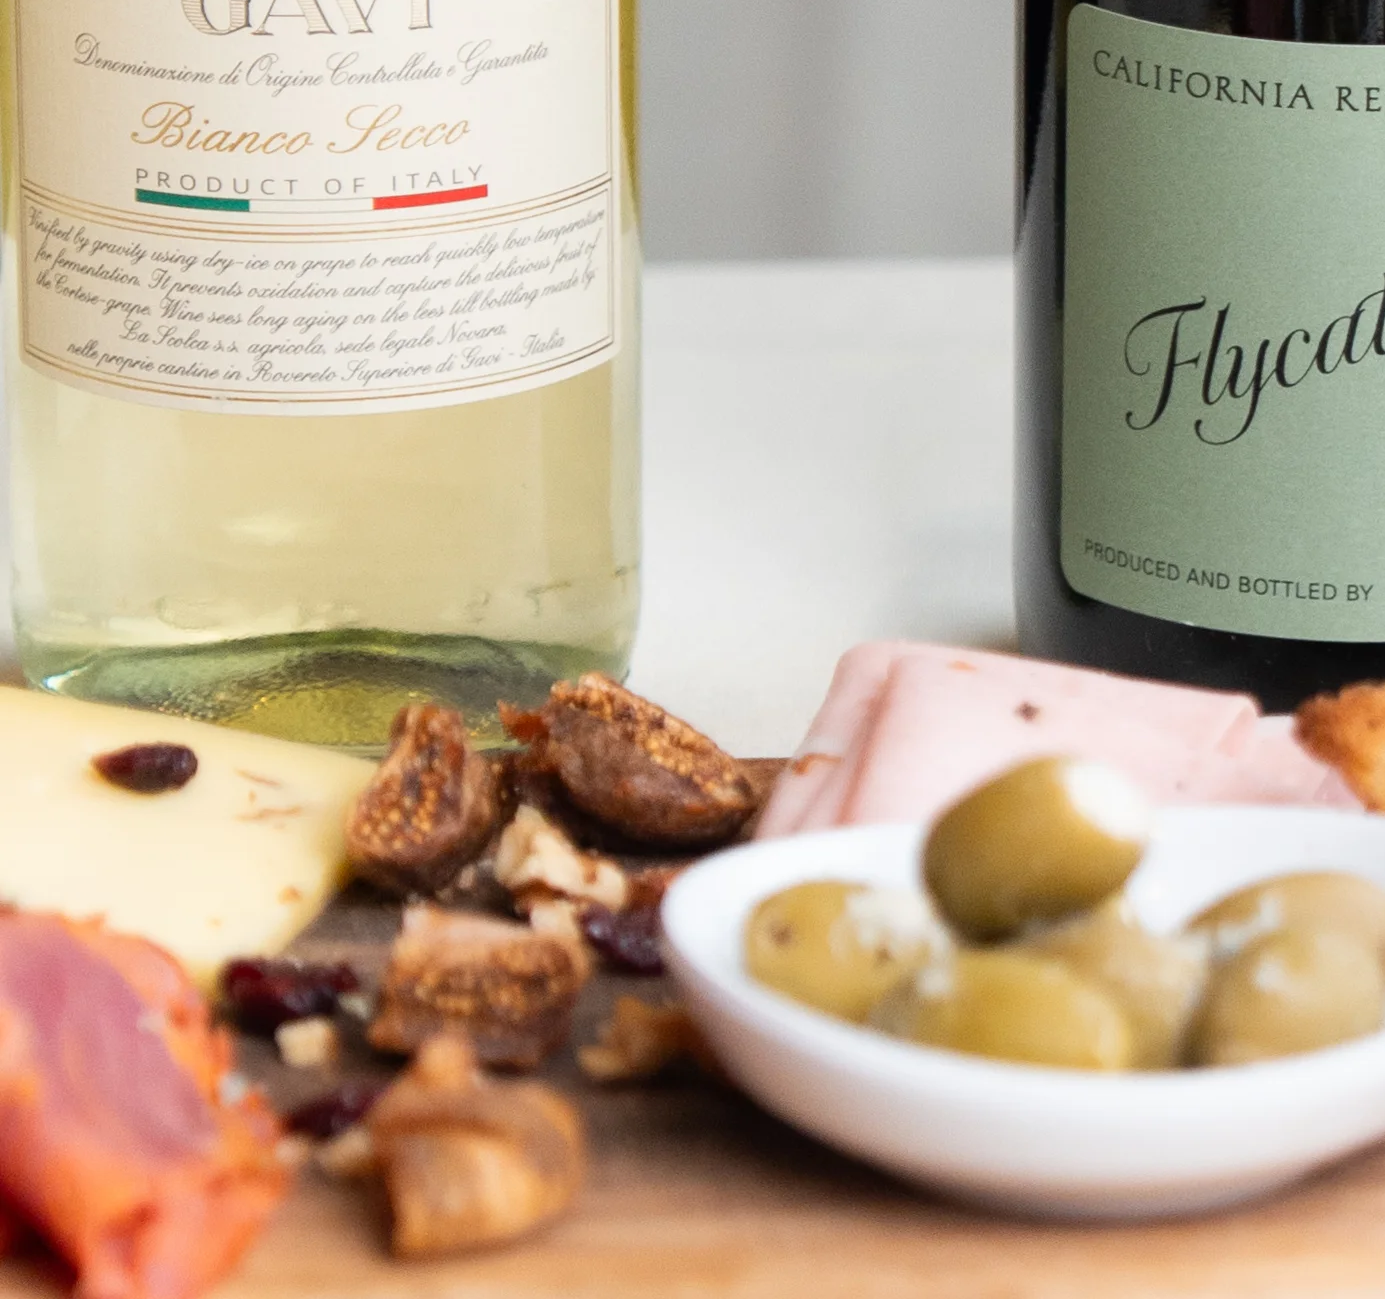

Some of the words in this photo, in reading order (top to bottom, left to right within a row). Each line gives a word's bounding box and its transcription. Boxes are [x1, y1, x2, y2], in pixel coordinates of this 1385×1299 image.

[73, 32, 215, 85] Denominazione
[218, 63, 240, 86] di
[245, 52, 323, 98] Origine
[325, 50, 442, 87] Controllata
[446, 65, 457, 77] e
[457, 38, 549, 86] Garantita
[1092, 49, 1315, 111] CALIFORNIA
[130, 101, 314, 155] Bianco
[326, 104, 471, 155] Secco
[135, 167, 299, 196] PRODUCT
[324, 177, 367, 196] OF
[391, 164, 484, 192] ITALY
[34, 241, 52, 263] for
[147, 267, 171, 290] It
[164, 278, 243, 300] prevents
[246, 280, 339, 299] oxidation
[342, 276, 387, 298] and
[385, 275, 452, 301] capture
[454, 262, 481, 287] the
[484, 255, 550, 283] delicious
[72, 226, 90, 253] by
[88, 241, 148, 265] gravity
[150, 247, 198, 272] using
[273, 259, 297, 271] on
[295, 259, 355, 279] grape
[359, 252, 378, 269] to
[381, 241, 432, 267] reach
[435, 231, 499, 269] quickly
[501, 227, 531, 252] low
[36, 268, 52, 290] the
[160, 297, 205, 320] Wine
[206, 311, 243, 325] sees
[246, 304, 290, 335] long
[292, 310, 350, 336] aging
[351, 312, 377, 326] on
[379, 299, 410, 325] the
[412, 297, 445, 321] lees
[448, 287, 485, 315] till
[478, 281, 540, 311] bottling
[540, 267, 580, 298] made
[66, 339, 100, 360] nelle
[95, 350, 155, 374] proprie
[157, 361, 220, 381] cantine
[222, 364, 242, 381] in
[245, 359, 337, 383] Rovereto
[340, 358, 433, 388] Superiore
[434, 353, 457, 374] di
[460, 346, 504, 371] Gavi
[519, 327, 566, 358] Italia
[118, 319, 150, 344] La
[151, 324, 211, 351] Scolca
[333, 333, 377, 355] sede
[379, 325, 437, 359] legale
[1084, 538, 1180, 581] PRODUCED
[1186, 568, 1230, 590] AND
[1238, 576, 1337, 601] BOTTLED
[1346, 584, 1373, 601] BY
